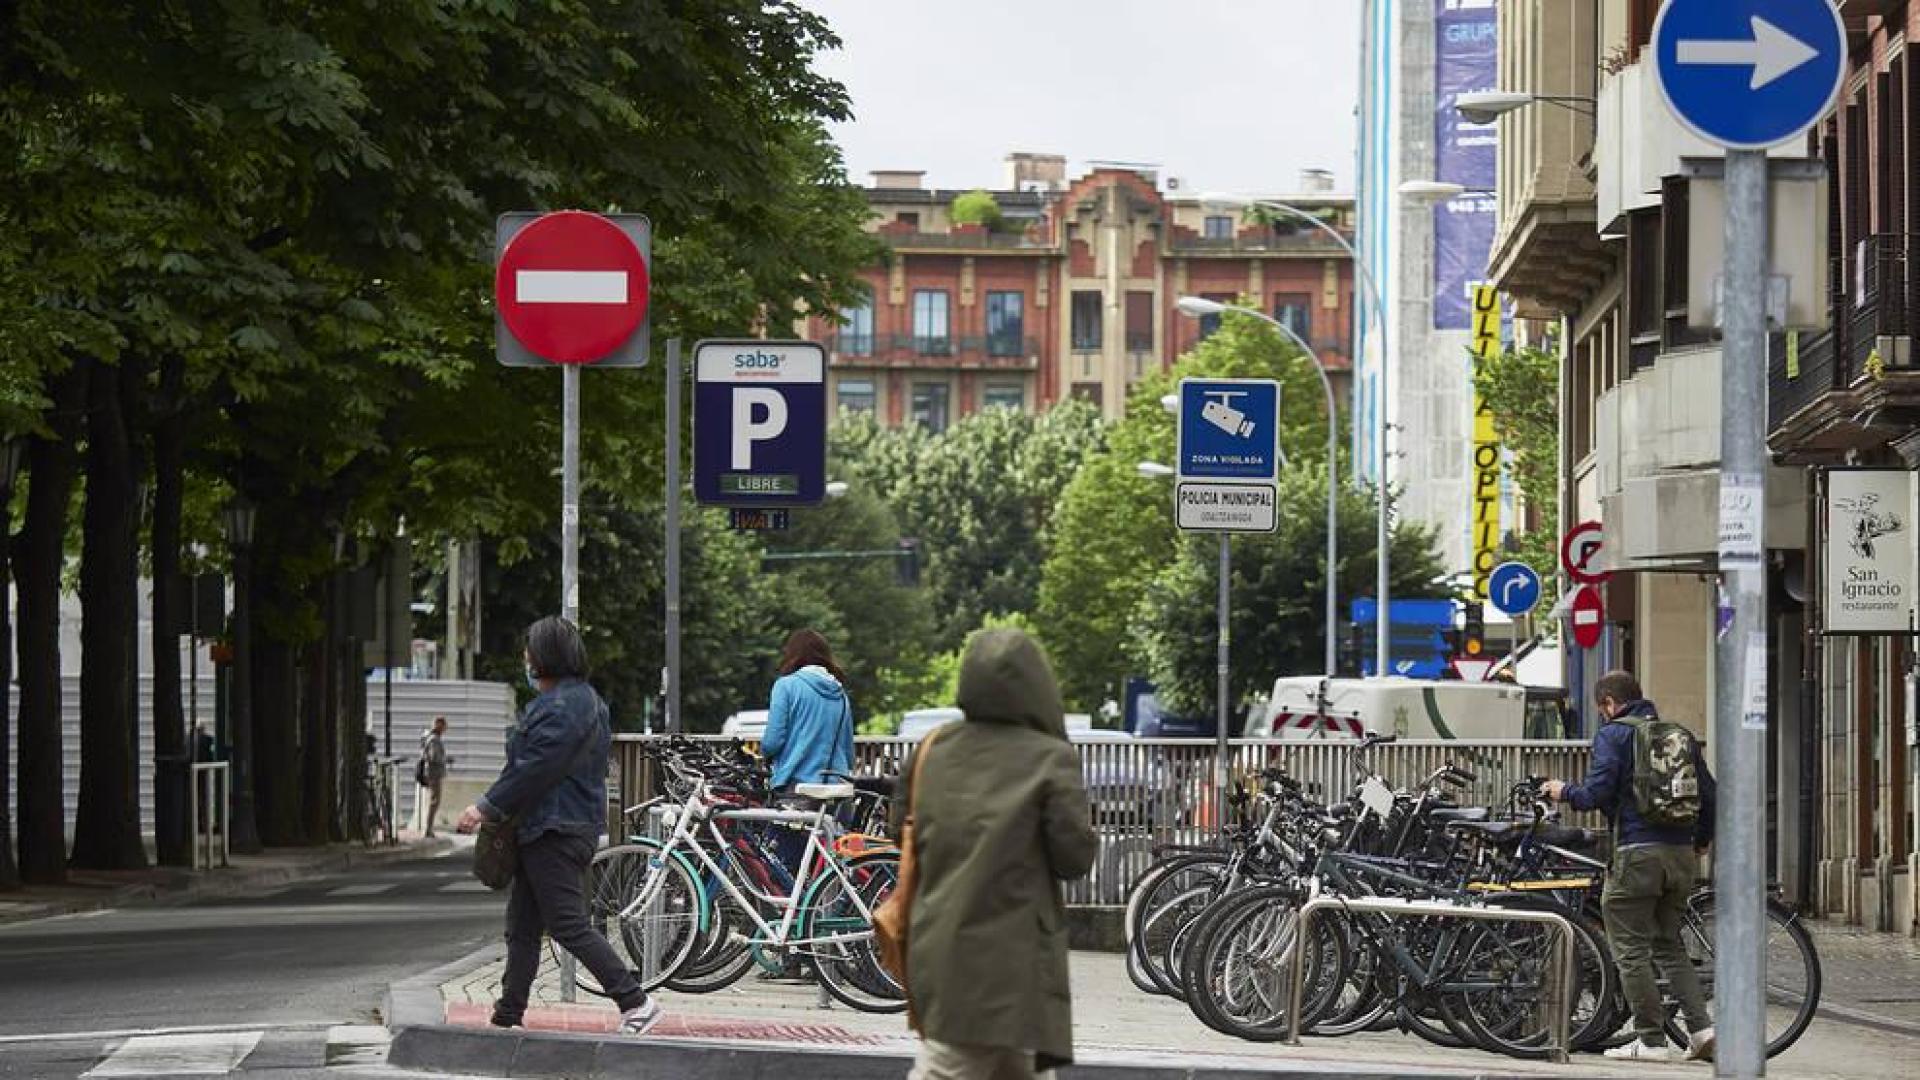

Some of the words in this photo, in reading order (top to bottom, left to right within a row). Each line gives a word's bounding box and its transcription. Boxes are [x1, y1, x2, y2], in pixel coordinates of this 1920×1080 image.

[735, 349, 779, 368] saba
[732, 387, 788, 470] P
[1192, 455, 1218, 464] ZONA
[1221, 455, 1264, 465] VIGILADA
[738, 478, 781, 490] LIBRE
[1222, 491, 1271, 507] MUNICIPAL
[1847, 565, 1878, 582] San
[1841, 580, 1901, 600] Ignacio
[1841, 601, 1899, 611] restaurante
